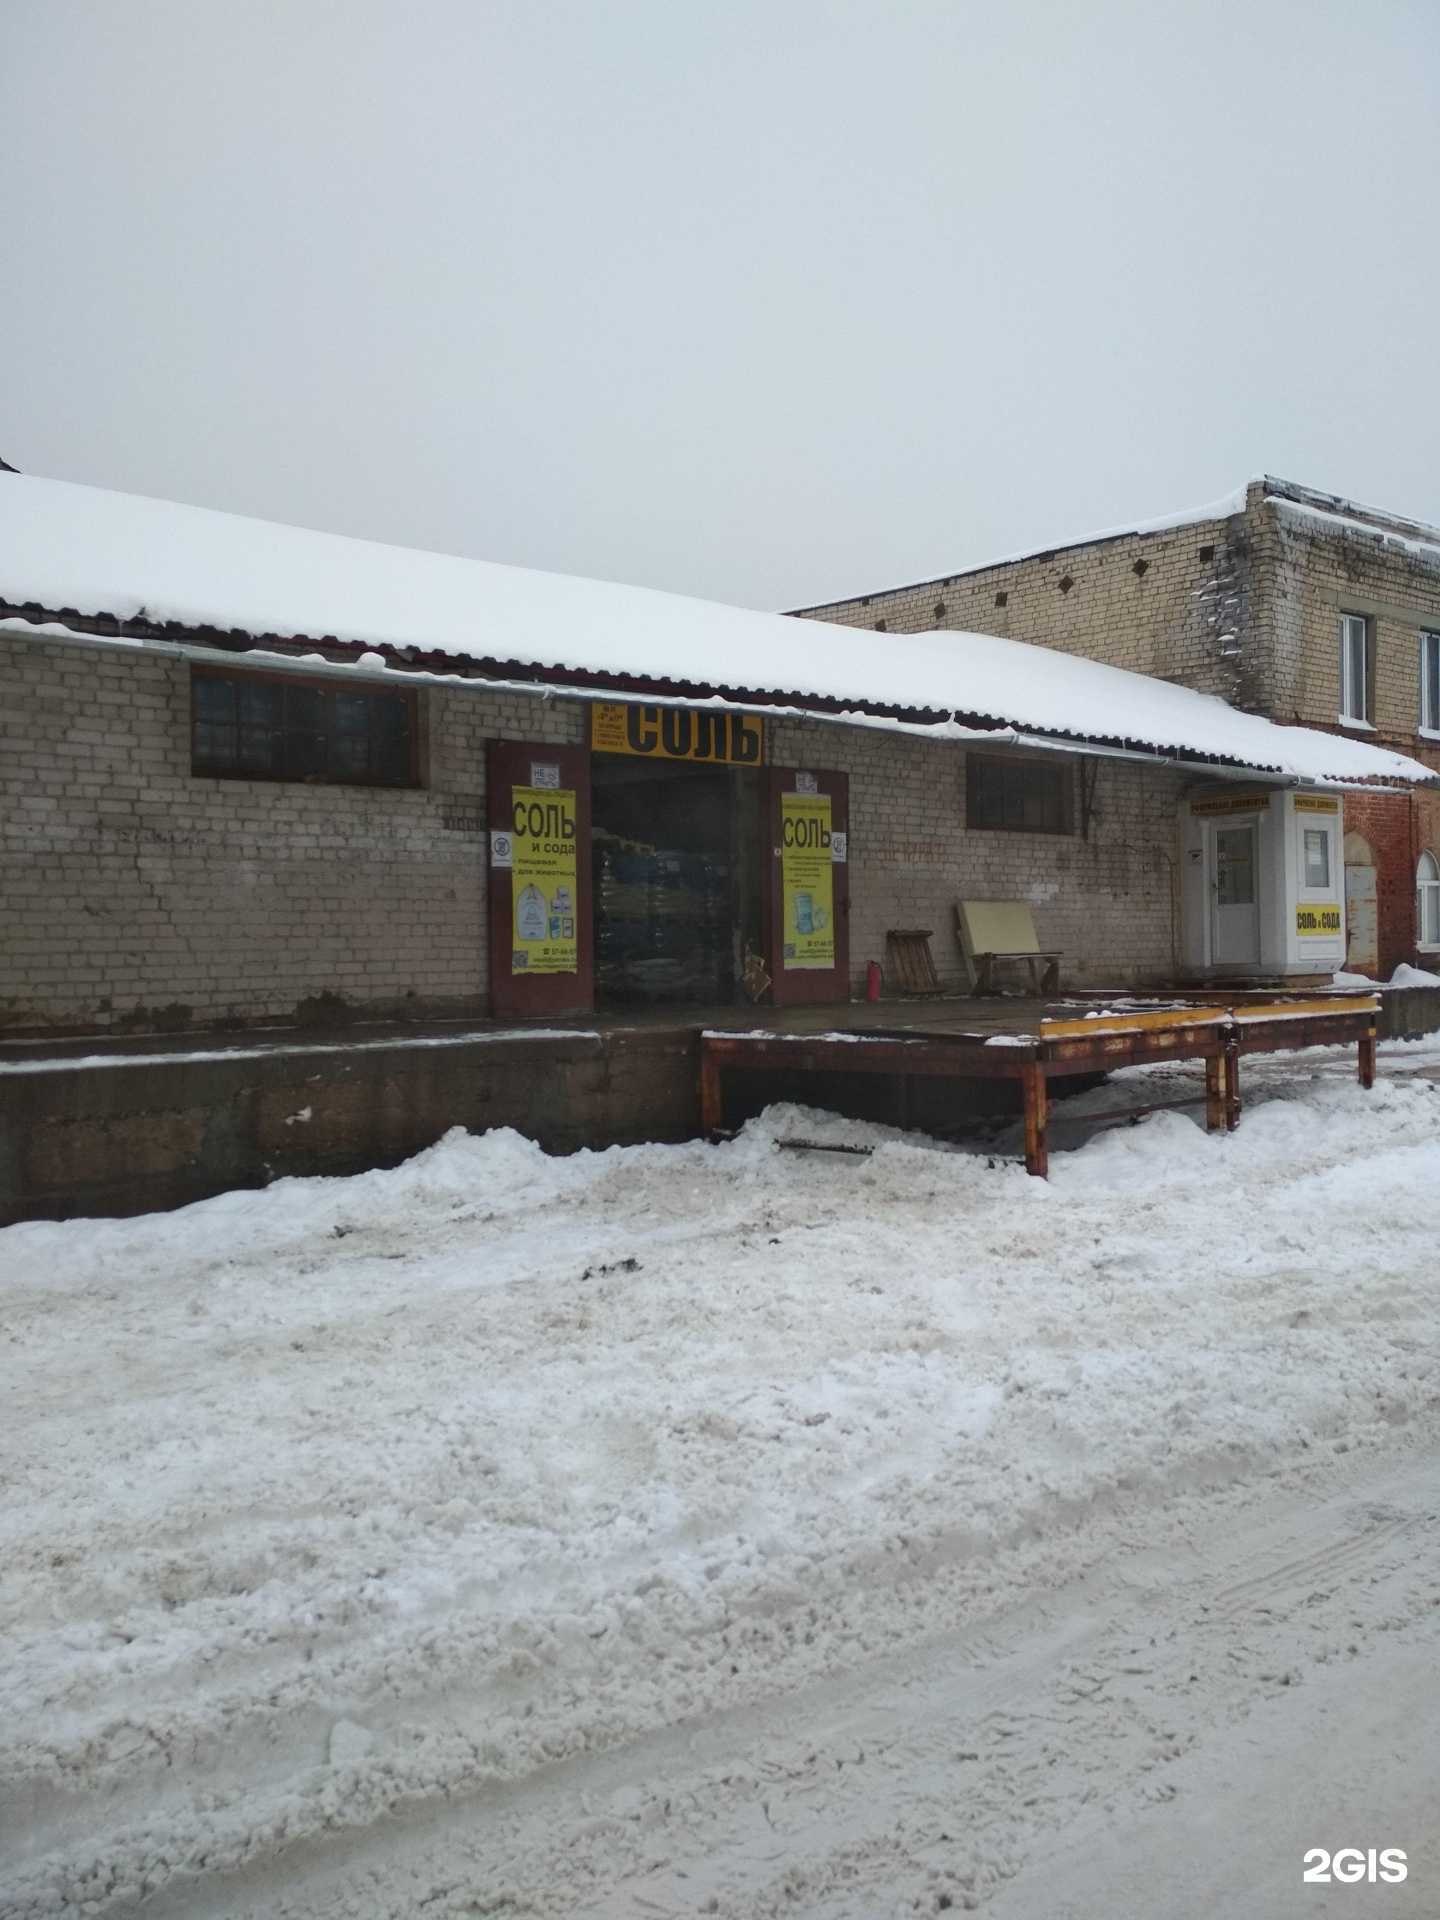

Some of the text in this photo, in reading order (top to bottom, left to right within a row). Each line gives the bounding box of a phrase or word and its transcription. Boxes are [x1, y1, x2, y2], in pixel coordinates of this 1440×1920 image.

[627, 704, 758, 762] СОЛЬ
[513, 801, 576, 839] СОЛЬ
[783, 816, 832, 848] СОЛЬ
[532, 842, 576, 856] и сода
[1297, 911, 1317, 930] СОЛЬ
[1322, 911, 1341, 931] СОДА
